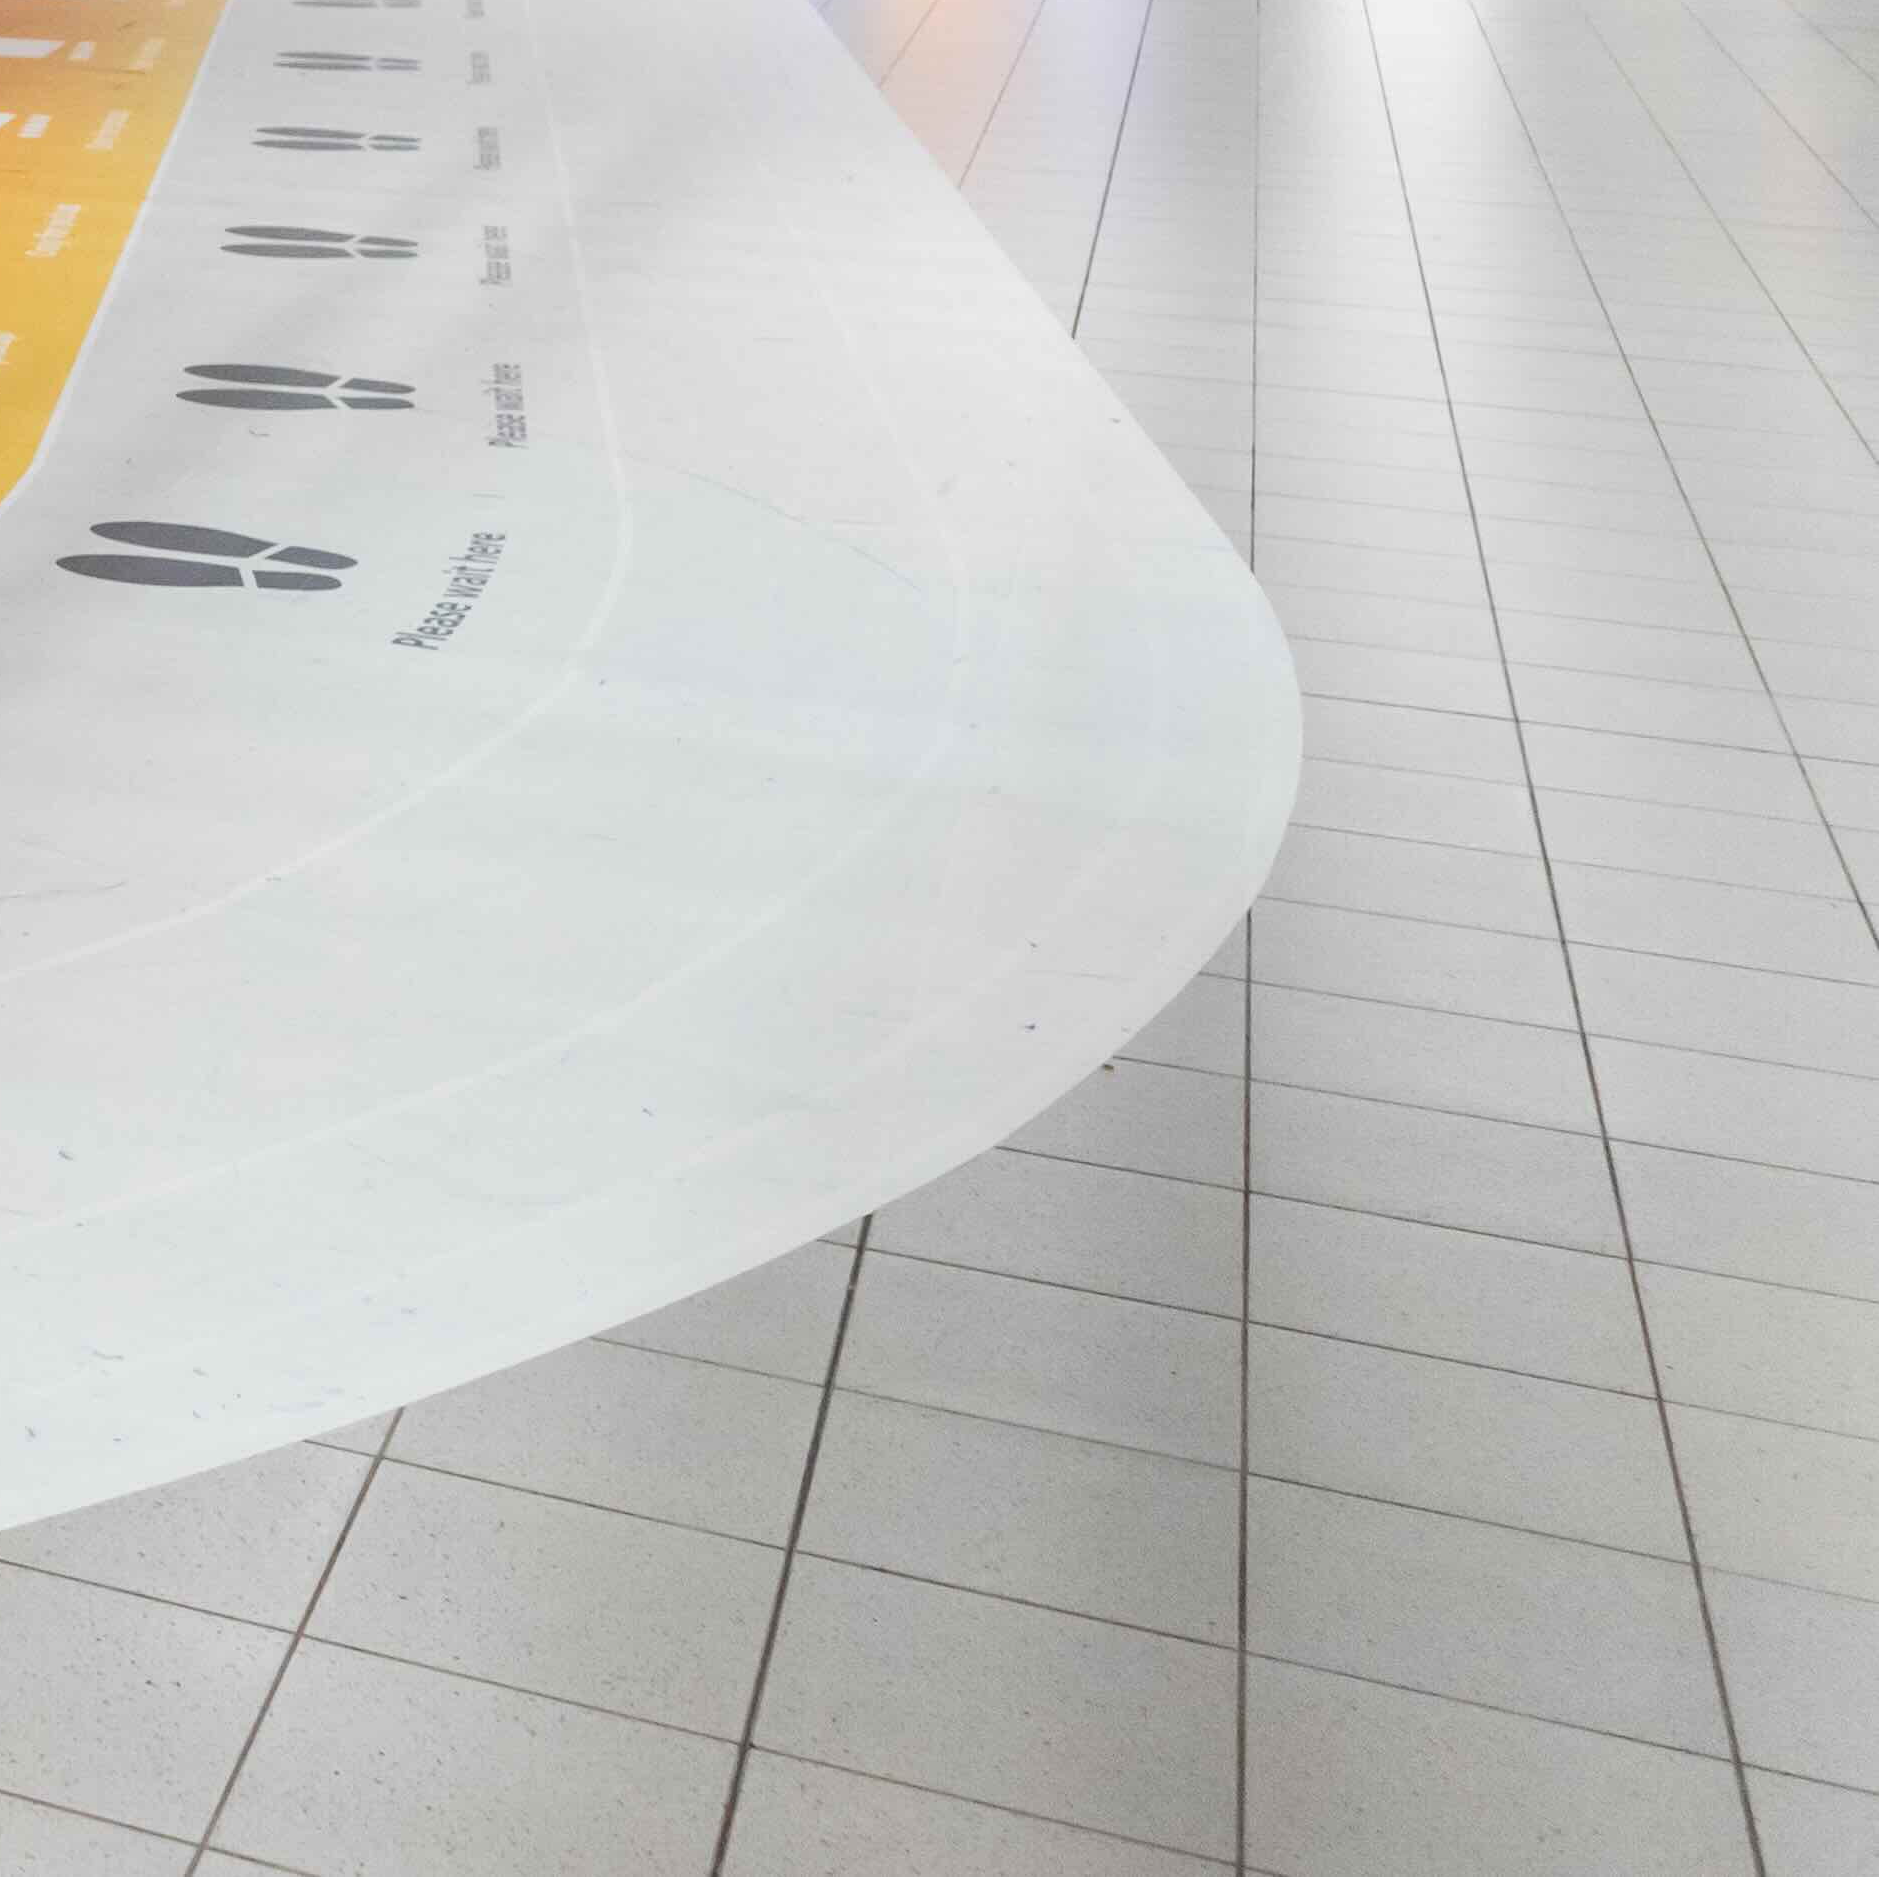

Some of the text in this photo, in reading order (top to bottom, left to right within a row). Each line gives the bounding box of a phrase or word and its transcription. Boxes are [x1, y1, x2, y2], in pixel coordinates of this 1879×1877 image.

[390, 531, 506, 650] Please wait here
